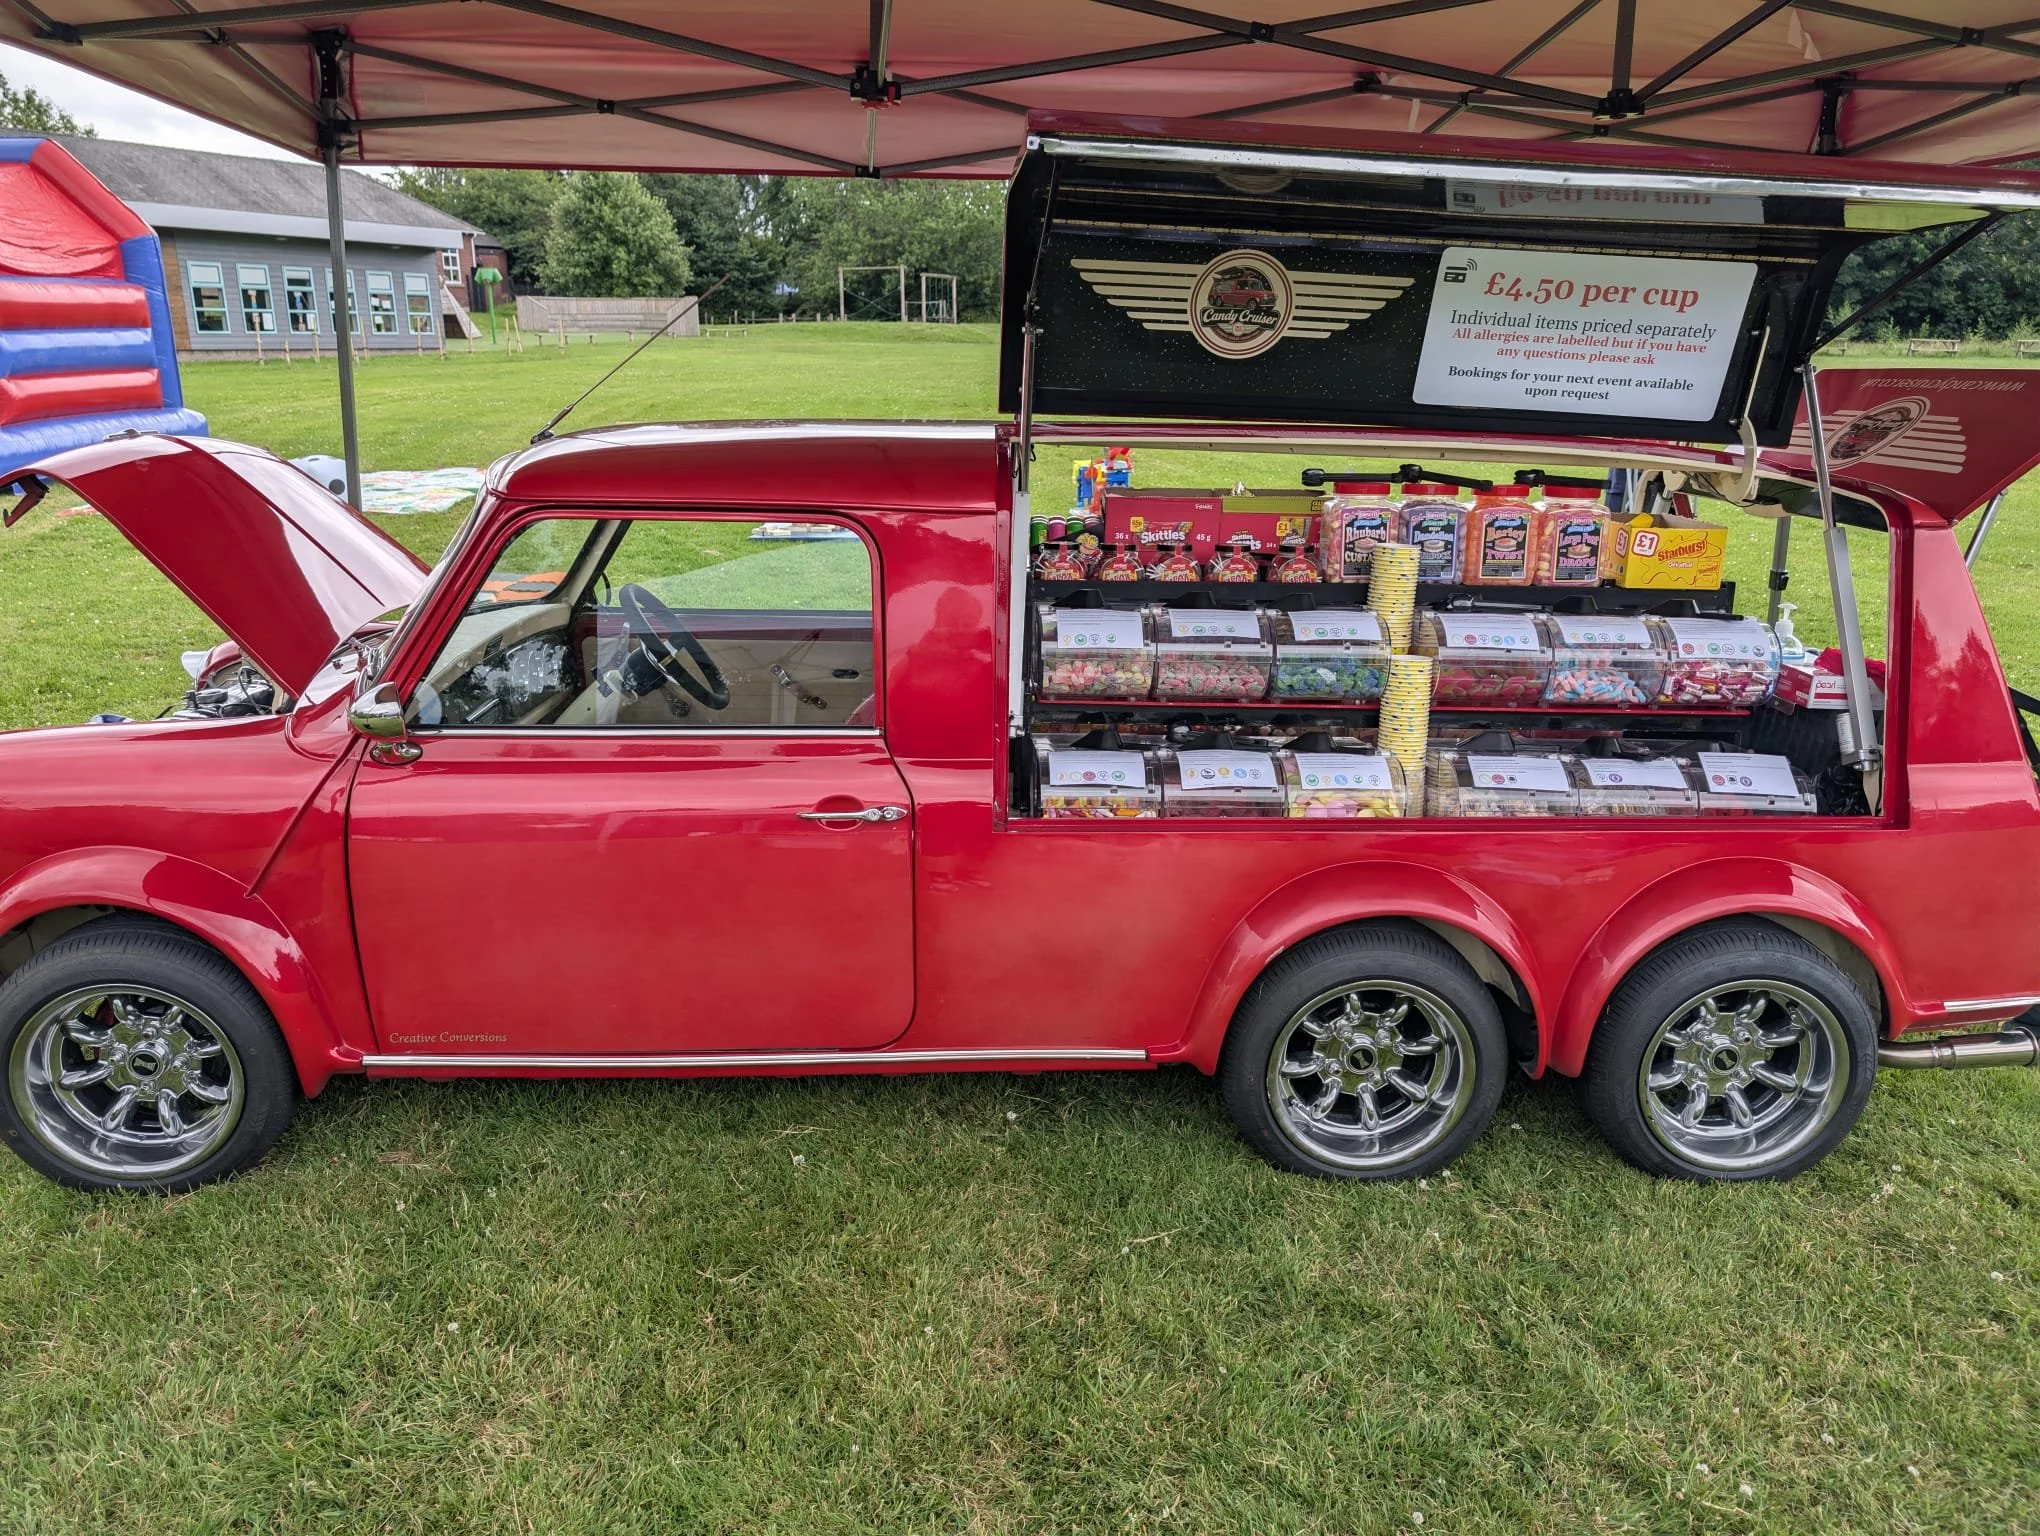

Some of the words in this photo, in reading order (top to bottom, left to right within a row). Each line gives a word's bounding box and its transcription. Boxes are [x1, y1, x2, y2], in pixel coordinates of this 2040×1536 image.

[1483, 271, 1574, 305] £4.50
[1578, 283, 1637, 308] per
[1642, 287, 1699, 314] cup
[1203, 309, 1238, 325] Candy
[1239, 309, 1278, 325] Cruiser
[1449, 309, 1532, 328] Individual
[1534, 314, 1579, 331] items
[1582, 317, 1633, 335] priced
[1635, 323, 1717, 343] separately
[1452, 327, 1472, 340] All
[1474, 329, 1530, 344] allergies
[1532, 334, 1555, 345] are
[1557, 333, 1609, 348] labelled
[1611, 336, 1634, 350] but
[1636, 338, 1649, 350] if
[1648, 342, 1673, 353] you
[1675, 340, 1708, 353] have
[1496, 347, 1521, 359] any
[1523, 348, 1586, 361] questions
[1588, 350, 1631, 364] please
[1633, 353, 1656, 365] ask
[1448, 365, 1508, 381] Bookings
[1510, 368, 1531, 381] for
[1532, 373, 1564, 384] your
[1566, 374, 1595, 385] next
[1597, 377, 1633, 387] event
[1635, 377, 1694, 391] available
[1525, 386, 1558, 399] upon
[1560, 389, 1610, 401] request
[1140, 529, 1187, 544] Skittles
[1196, 533, 1206, 541] 45
[1345, 526, 1386, 543] Rhubarb
[1637, 535, 1655, 550] £1
[1486, 549, 1525, 560] TWIST
[1657, 540, 1707, 562] Starburst
[1559, 557, 1596, 567] DROPS
[389, 1032, 437, 1044] Creative
[439, 1031, 508, 1043] Conversions
